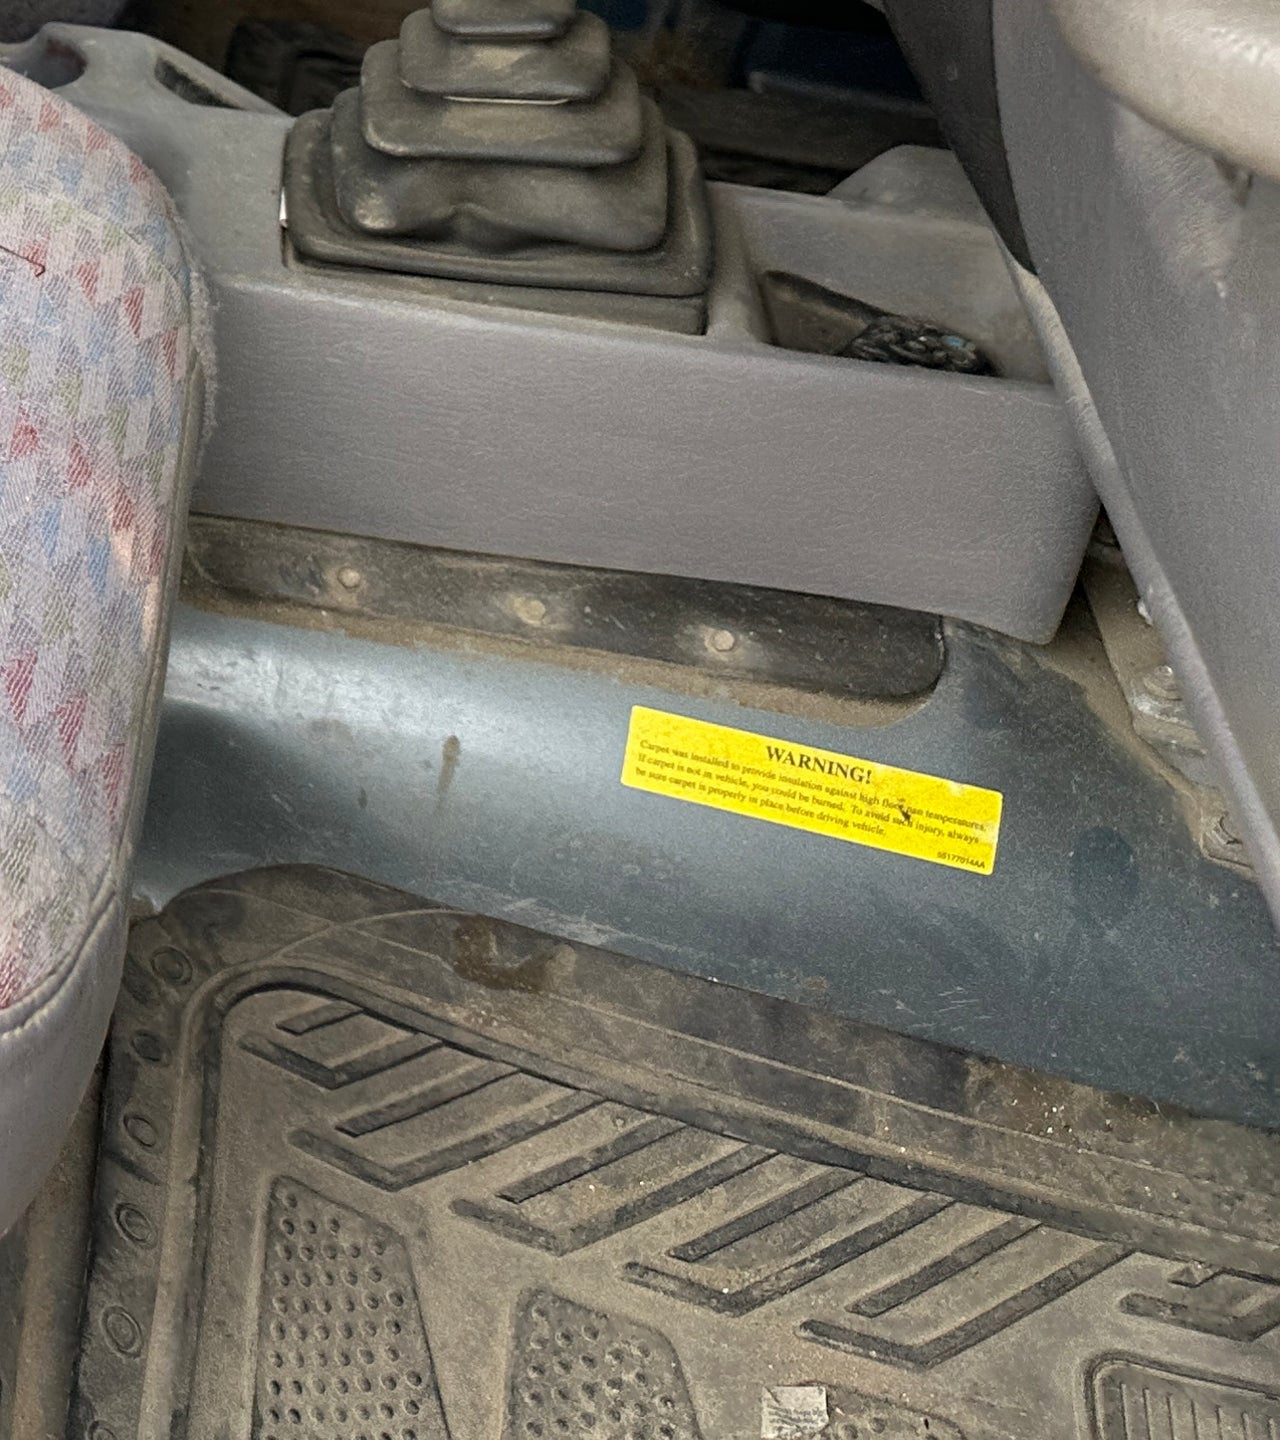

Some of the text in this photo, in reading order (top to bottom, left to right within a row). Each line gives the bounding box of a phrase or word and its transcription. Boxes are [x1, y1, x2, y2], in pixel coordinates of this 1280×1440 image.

[639, 739, 669, 755] Carpet
[671, 748, 688, 758] was
[690, 751, 729, 768] installed
[741, 764, 776, 781] provide
[778, 773, 822, 791] insulation
[825, 784, 857, 800] against
[858, 792, 880, 806] high
[765, 745, 872, 784] WARNING!
[647, 756, 674, 771] carpet
[686, 765, 701, 775] not
[751, 782, 769, 794] you
[865, 808, 890, 822] avoid
[947, 828, 979, 846] always
[648, 771, 666, 781] sure
[668, 776, 695, 790] carpet
[707, 784, 746, 802] properly
[759, 797, 784, 811] place
[785, 803, 814, 818] before
[816, 811, 849, 828] driving
